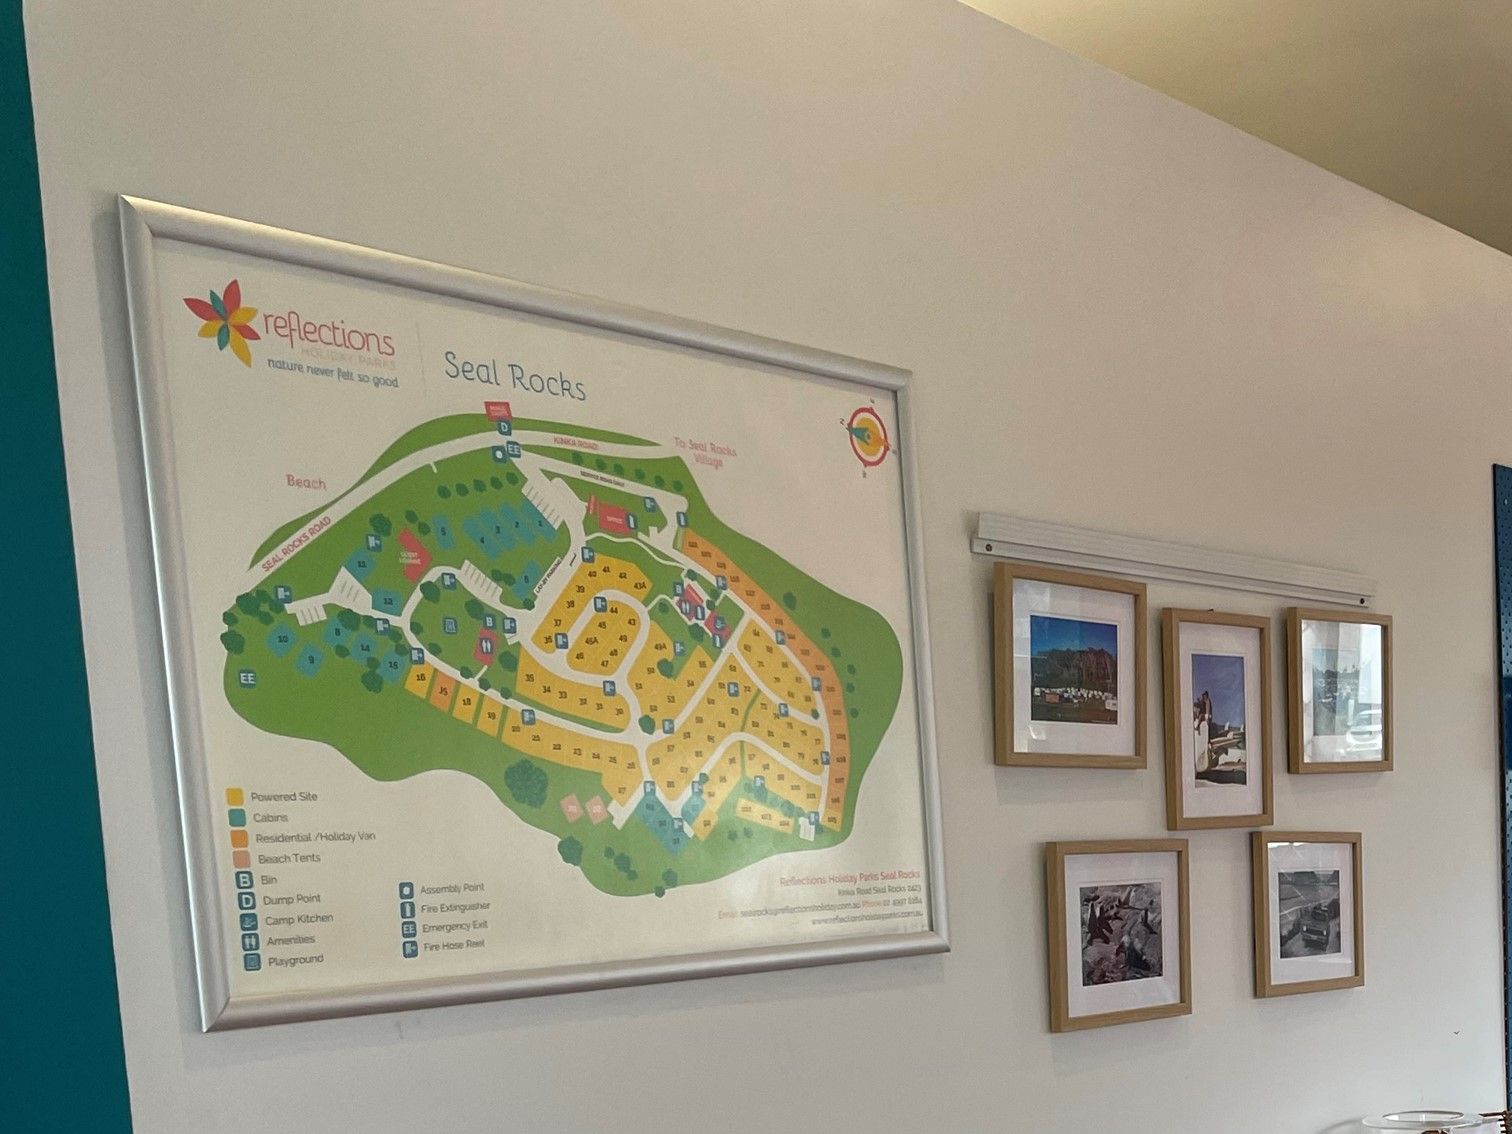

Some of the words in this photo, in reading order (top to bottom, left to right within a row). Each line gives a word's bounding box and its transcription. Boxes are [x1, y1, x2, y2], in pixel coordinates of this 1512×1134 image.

[263, 311, 396, 357] reflections
[267, 357, 303, 374] nature
[306, 363, 335, 380] never
[337, 366, 355, 384] felt
[357, 372, 370, 384] so
[372, 374, 399, 389] good
[444, 350, 500, 387] Seal
[508, 363, 588, 402] Rocks
[500, 422, 509, 433] D
[508, 444, 522, 455] EE
[577, 440, 598, 451] ROAD
[674, 437, 688, 448] To
[688, 440, 709, 452] Seal
[709, 442, 738, 457] Rocks
[694, 453, 723, 470] Village
[287, 471, 327, 492] Beach
[261, 552, 283, 572] SEAL
[282, 532, 309, 555] ROCKS
[308, 516, 332, 539] ROAD
[576, 585, 585, 593] 39
[634, 581, 647, 590] 43A
[554, 619, 562, 627] 37
[309, 656, 314, 664] 9
[240, 673, 256, 684] EE
[525, 674, 534, 682] 35
[463, 698, 471, 706] 18
[487, 712, 496, 720] 19
[251, 792, 297, 802] Powered
[299, 791, 318, 802] Site
[253, 812, 288, 823] Cabins
[256, 832, 312, 843] Residential
[357, 831, 376, 841] Van
[258, 853, 292, 865] Beach
[293, 852, 321, 863] Tents
[239, 874, 251, 886] B
[261, 875, 278, 885] Bin
[780, 876, 827, 887] Reflections
[828, 874, 857, 886] Holiday
[859, 872, 880, 882] Parks
[880, 871, 897, 880] Seal
[898, 870, 921, 879] Rocks
[420, 884, 462, 897] Assembly
[463, 882, 485, 892] Point
[873, 886, 886, 894] Seal
[887, 885, 906, 893] Rocks
[242, 895, 253, 907] D
[263, 895, 294, 907] Dump
[296, 893, 321, 904] Point
[421, 904, 439, 914] Fire
[440, 901, 491, 915] Extinguisher
[265, 916, 295, 928] Camp
[297, 913, 334, 924] Kitchen
[404, 925, 416, 933] EE
[422, 923, 471, 935] Emergency
[472, 920, 488, 930] Exit
[267, 934, 315, 946] Amenities
[424, 943, 441, 952] Fire
[441, 941, 461, 951] Hose
[463, 939, 485, 949] Reel
[268, 954, 324, 969] Playground
